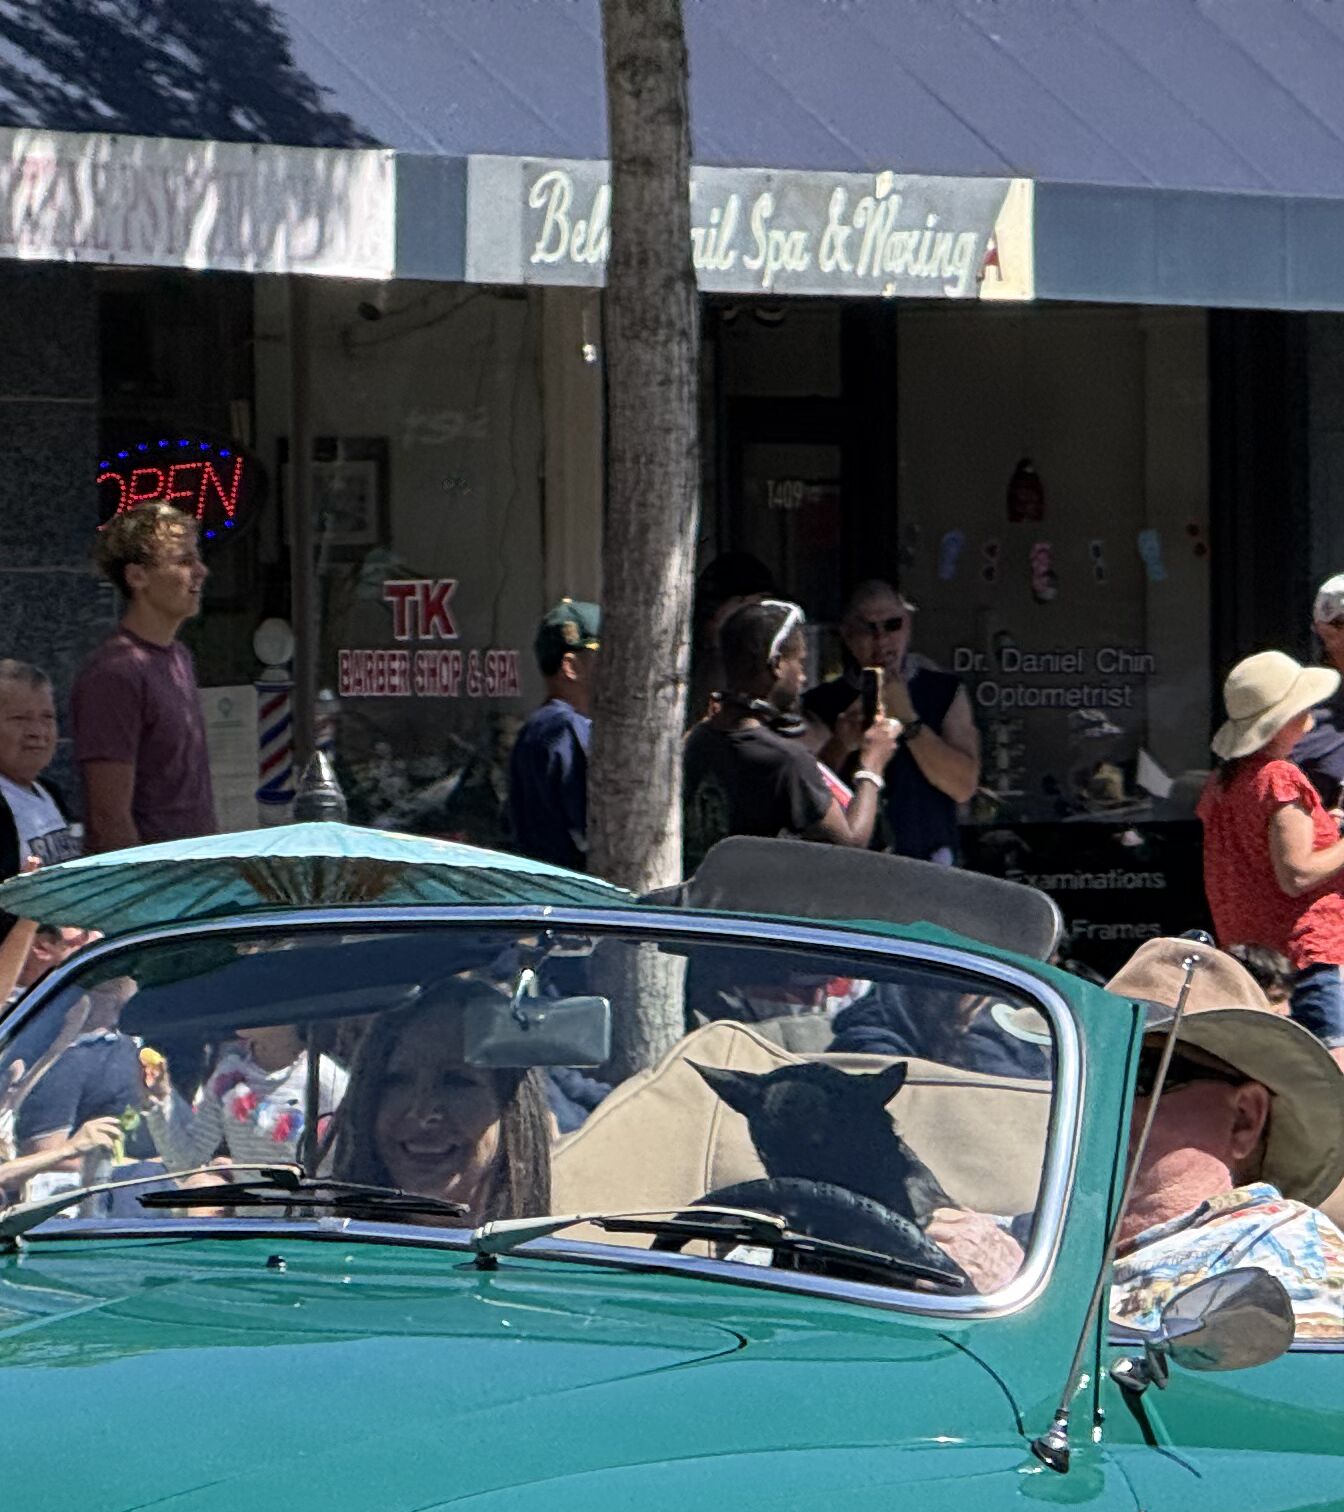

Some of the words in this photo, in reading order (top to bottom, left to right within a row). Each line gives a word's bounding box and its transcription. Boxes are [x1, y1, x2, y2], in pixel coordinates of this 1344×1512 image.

[742, 191, 811, 288] Spa
[818, 186, 854, 273] &
[383, 579, 459, 641] TK
[339, 649, 412, 697] BARBER
[414, 649, 463, 697] SHOP
[467, 650, 482, 697] &
[484, 650, 521, 697] SPA
[954, 647, 991, 673] Dr.
[1001, 647, 1083, 673] Daniel
[1096, 648, 1155, 673] Chin
[975, 681, 1133, 711] Optometrist
[1005, 868, 1167, 890] Examinations
[1071, 918, 1162, 941] Frames
